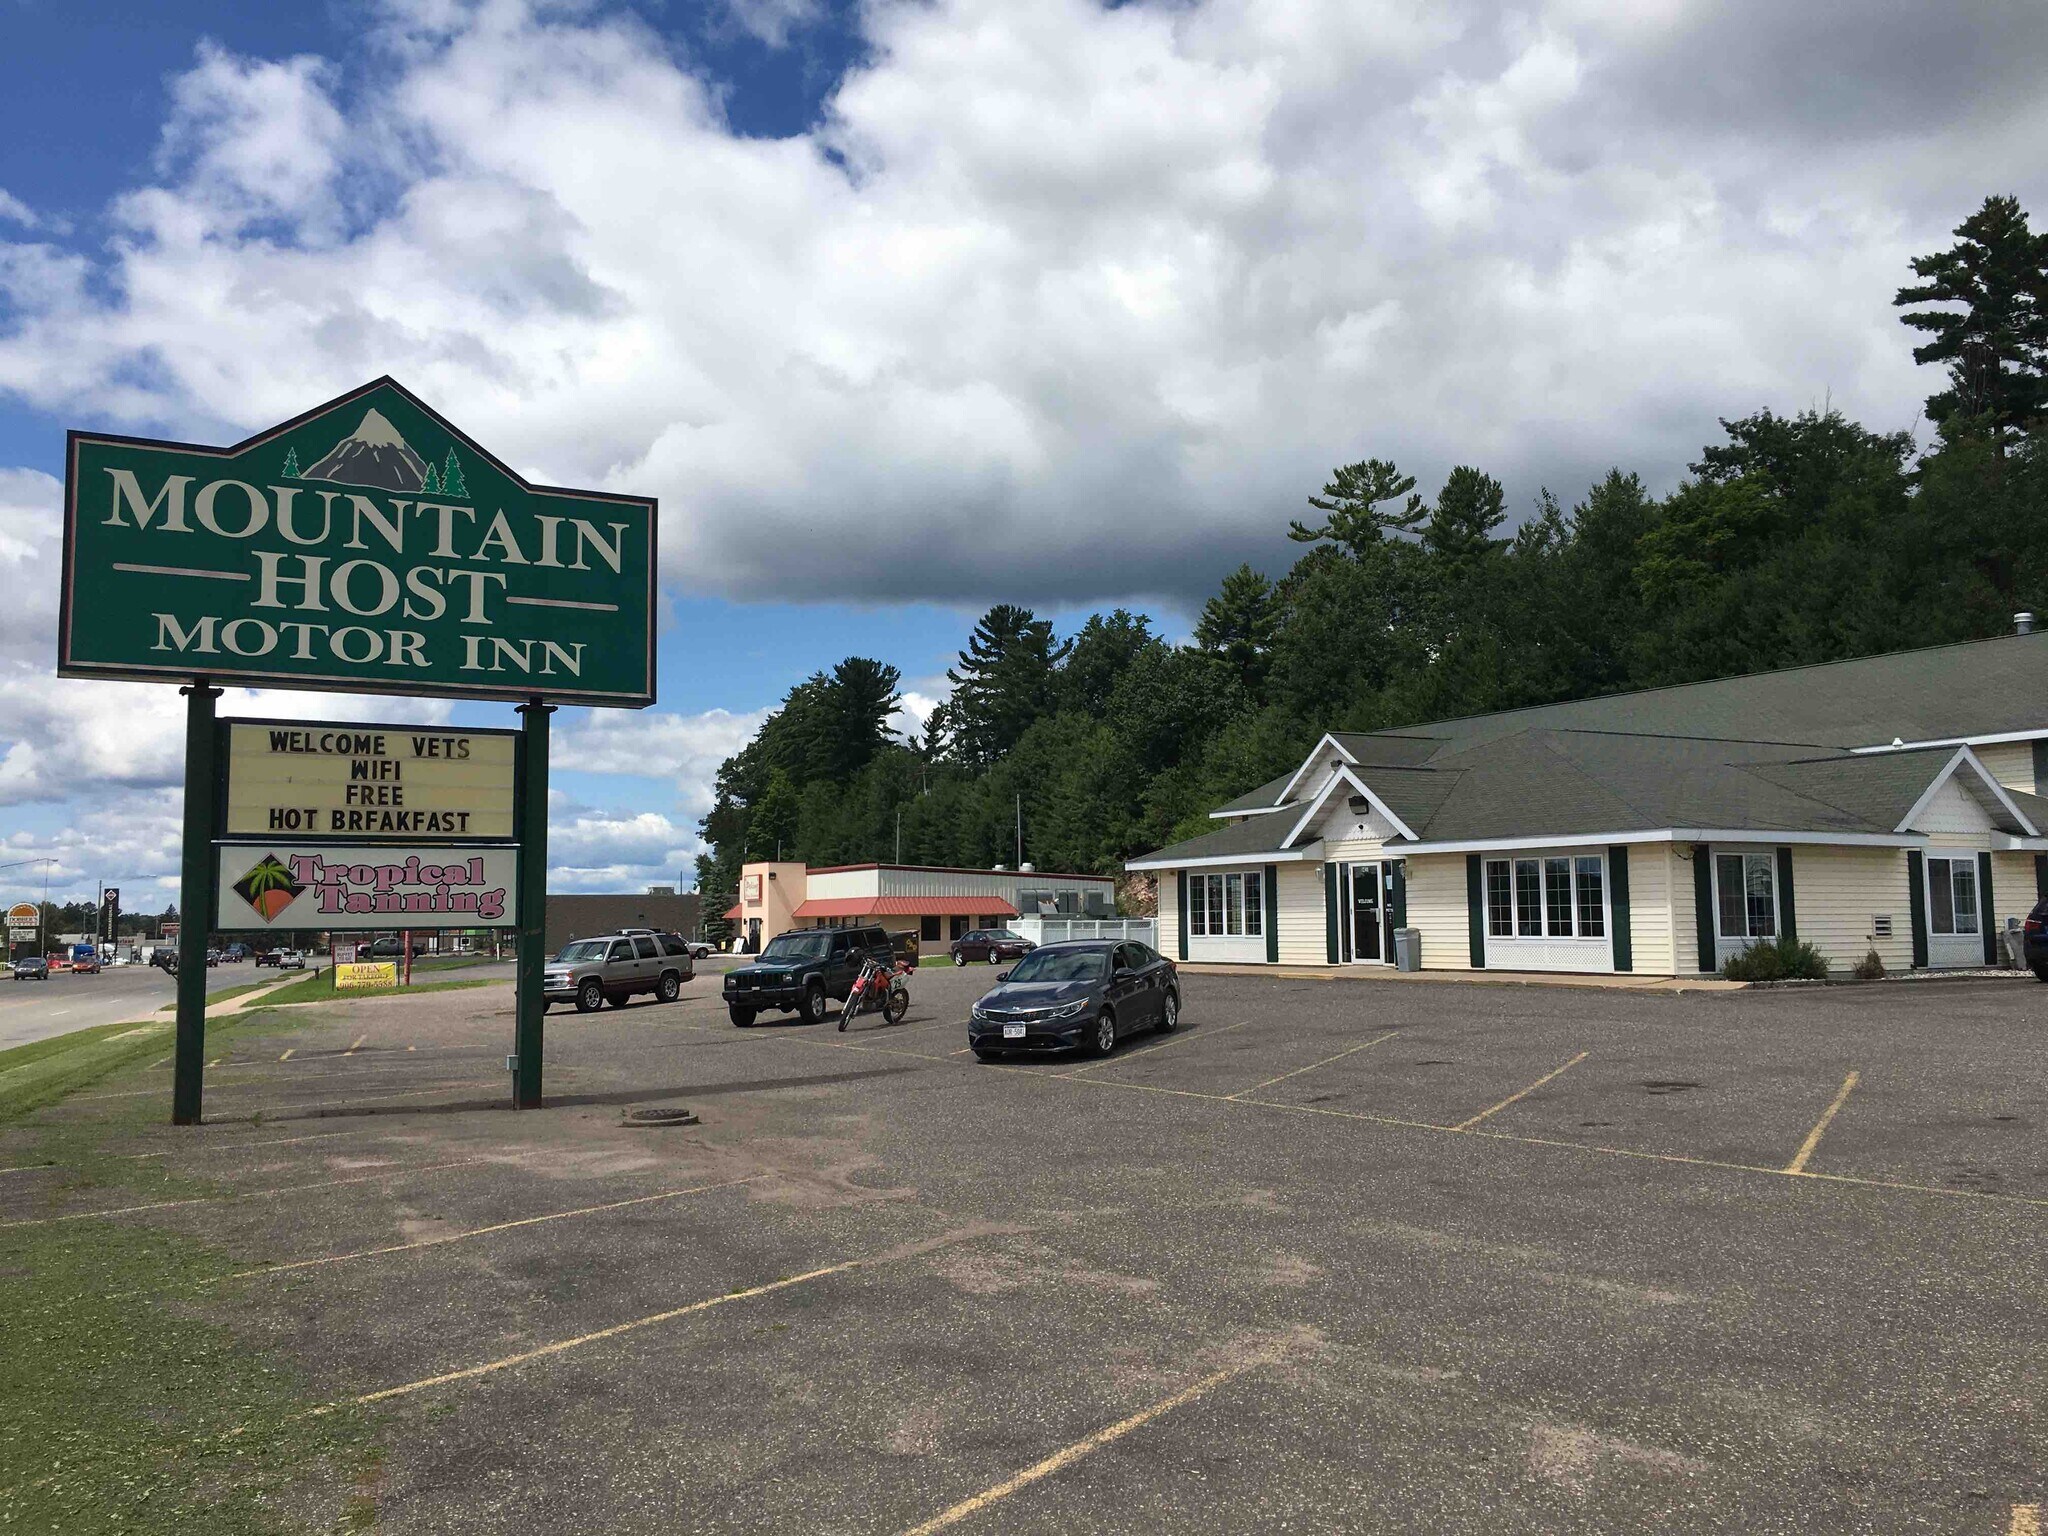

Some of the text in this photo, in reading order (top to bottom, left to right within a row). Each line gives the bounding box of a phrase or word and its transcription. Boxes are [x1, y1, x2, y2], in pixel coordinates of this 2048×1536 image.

[101, 467, 630, 574] MOUNTAIN
[250, 550, 507, 625] HOST
[150, 613, 587, 677] MOTOR INN
[269, 731, 470, 758] WELCOME VETS
[351, 760, 401, 780] WIFI
[346, 785, 403, 806] FREE
[269, 809, 318, 829] HOT
[289, 854, 486, 892] Tropical
[314, 884, 506, 919] Tanning
[352, 964, 380, 974] OPEN
